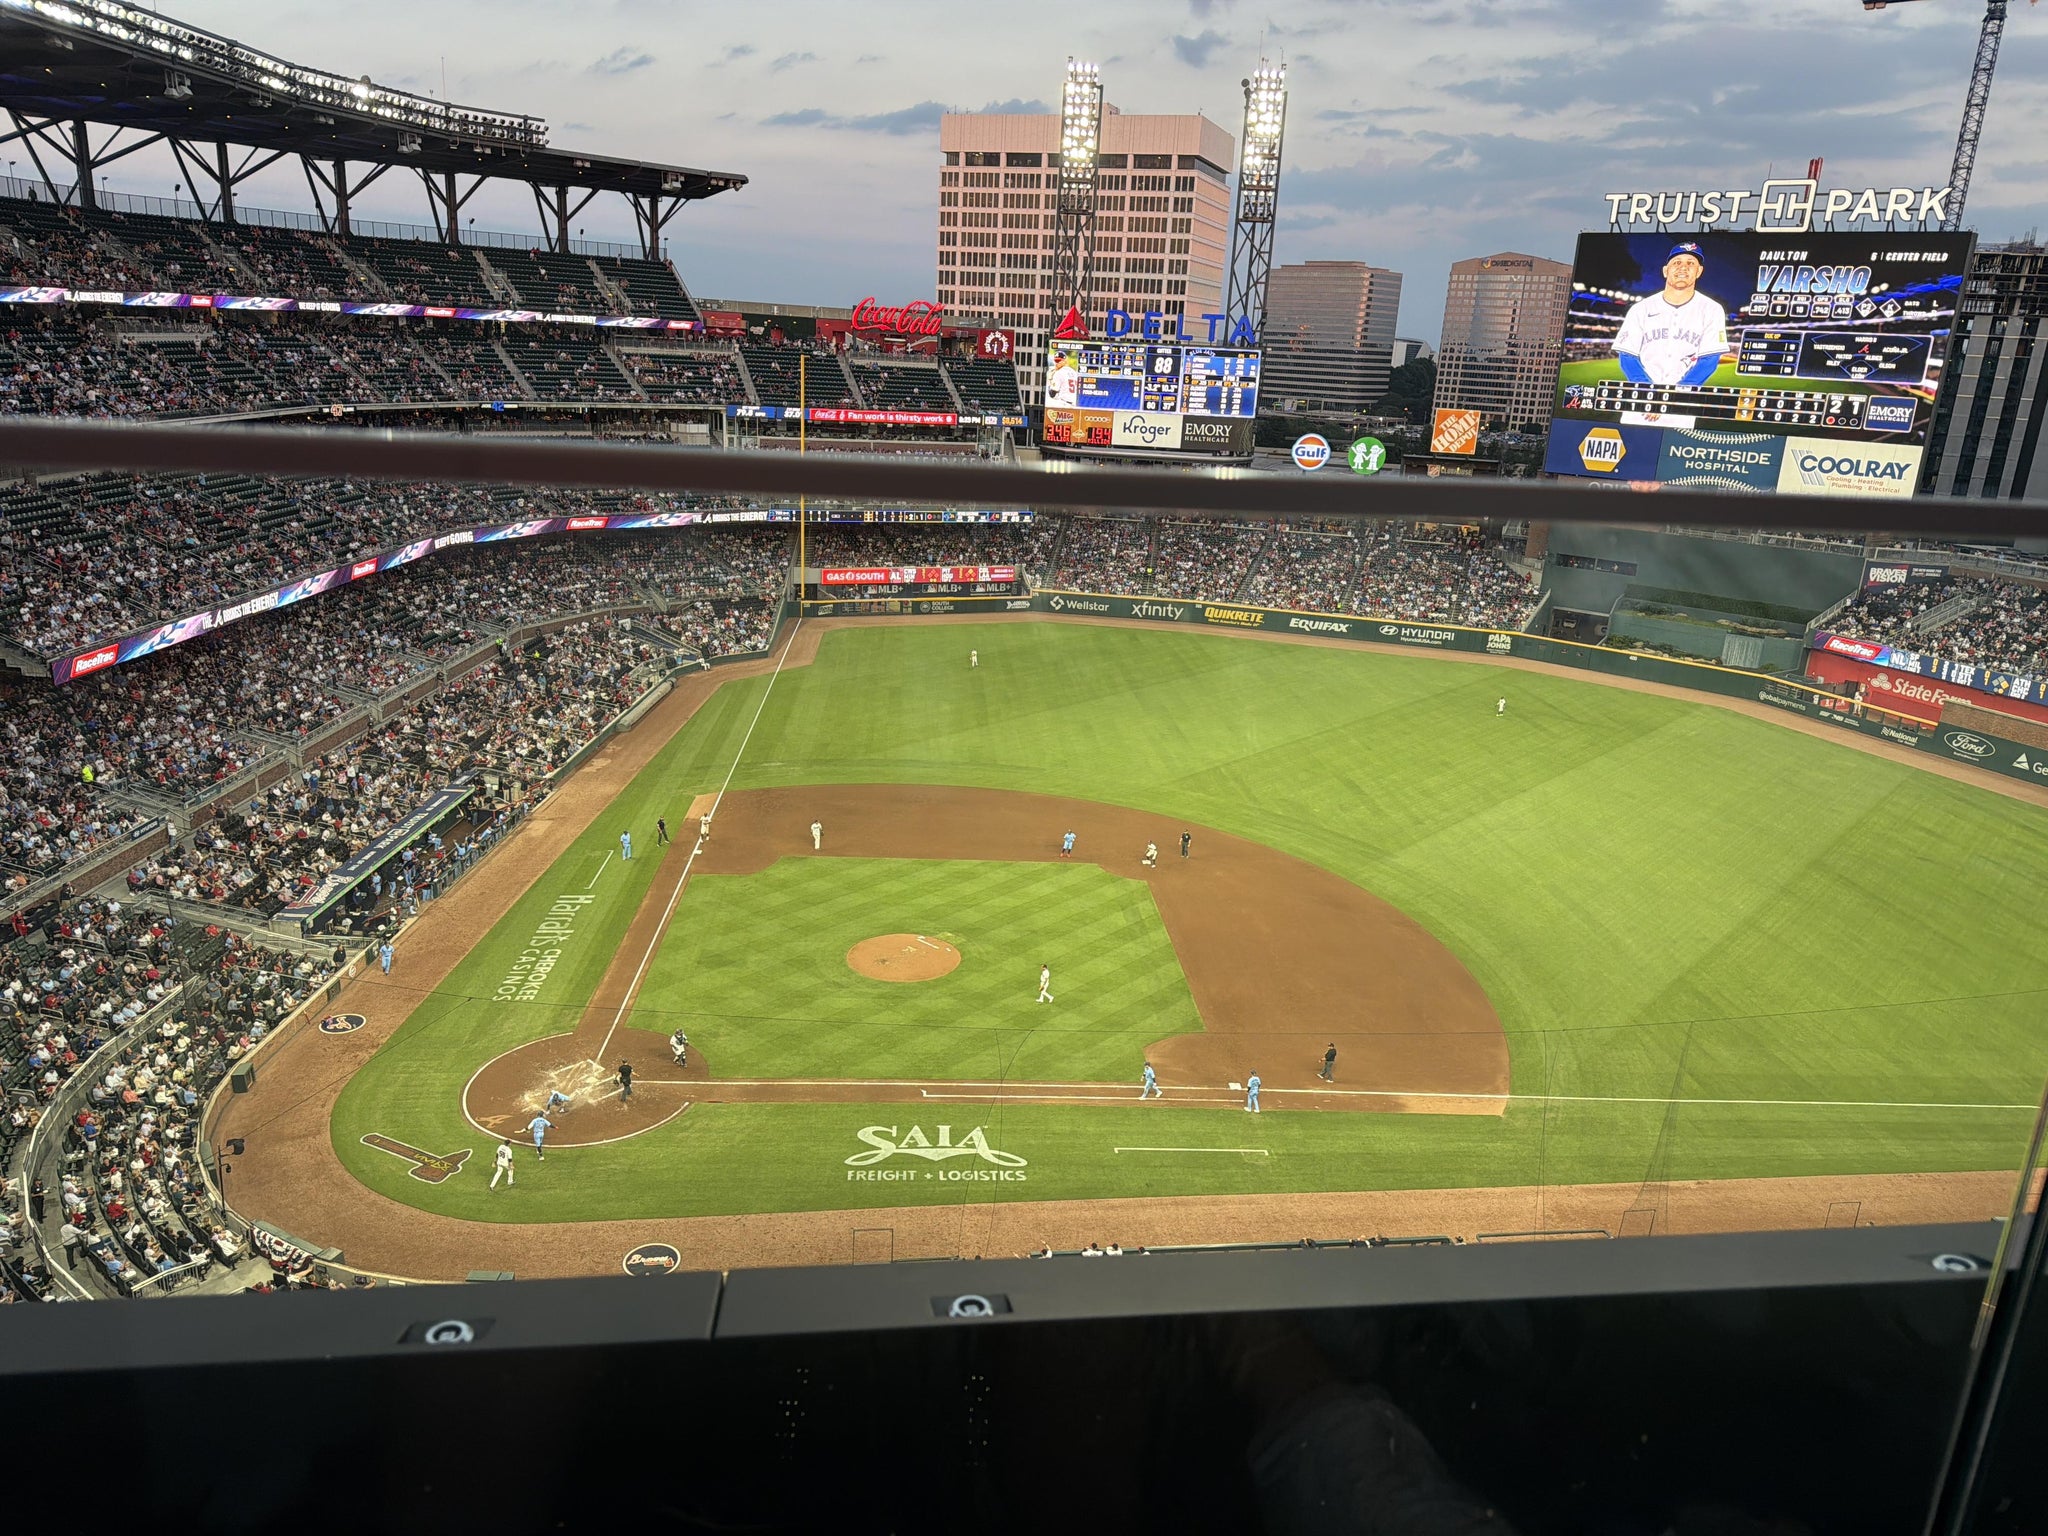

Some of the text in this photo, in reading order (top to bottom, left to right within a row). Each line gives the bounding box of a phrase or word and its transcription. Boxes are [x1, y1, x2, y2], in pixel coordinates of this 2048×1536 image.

[1604, 187, 1952, 223] TRUIST PARK
[1759, 250, 1808, 261] DAULTON
[1885, 252, 1948, 262] CENTER FIELD
[1756, 265, 1872, 294] VARSHO
[1106, 309, 1256, 345] DELTA
[1154, 357, 1173, 374] 88
[492, 402, 504, 411] 42
[1601, 389, 1608, 397] 0
[1616, 390, 1623, 398] 2
[1632, 391, 1638, 399] 0
[1647, 391, 1653, 400] 0
[1662, 392, 1669, 401] 0
[1777, 400, 1784, 408] 0
[1794, 401, 1801, 410] 2
[1813, 402, 1818, 411] 1
[1830, 400, 1841, 414] 2
[1614, 402, 1621, 410] 0
[1631, 403, 1636, 411] 1
[1645, 404, 1651, 412] 0
[1660, 405, 1667, 413] 0
[1741, 410, 1748, 418] 3
[1757, 411, 1764, 420] 4
[1774, 413, 1782, 421] 0
[1792, 414, 1799, 422] 2
[1809, 415, 1816, 424] 2
[1852, 401, 1860, 415] 1
[1869, 405, 1913, 418] EMORY
[848, 411, 862, 419] Fan
[865, 412, 884, 420] work
[896, 413, 921, 422] thirsty
[923, 414, 943, 422] work
[1439, 414, 1458, 431] THE
[1868, 415, 1909, 423] HEALTHCARE
[1047, 424, 1071, 436] 346
[1092, 427, 1112, 439] 194
[1123, 415, 1171, 443] Kroger
[1185, 423, 1232, 437] EMORY
[1432, 411, 1480, 452] HOME
[1448, 426, 1477, 452] DEPOT
[1295, 446, 1326, 459] Gulf
[1585, 441, 1619, 460] NAPA
[1669, 445, 1772, 466] NORTHSIDE
[1685, 461, 1749, 474] HOSPITAL
[1800, 454, 1912, 480] COOLRAY
[1826, 475, 1884, 486] Cooling Heating
[1831, 482, 1900, 494] Plumbing Electrical
[740, 510, 768, 522] ENERGY
[450, 531, 473, 545] GOING
[826, 572, 885, 581] GAS SOUTH
[890, 571, 901, 580] AL
[1869, 574, 1907, 584] VISION
[1870, 567, 1908, 577] BRAVES
[938, 583, 962, 593] MLB+
[986, 583, 1011, 592] MLB+
[250, 592, 279, 614] ENERGY
[1066, 600, 1110, 612] Wellstar
[1131, 601, 1184, 620] xfinity
[1204, 607, 1264, 623] QUIKRETE
[1289, 617, 1348, 633] EQUIFAX
[1401, 627, 1455, 641] HYUNDAI
[1488, 634, 1511, 643] PAPA
[1486, 641, 1511, 650] JOHNS
[1829, 639, 1874, 657] RaceTrac
[75, 651, 114, 672] RaceTrac
[1890, 653, 1906, 666] NL
[1959, 664, 1975, 675] TEX
[1892, 678, 1931, 702] State
[2013, 678, 2031, 688] ATH
[1890, 730, 1918, 744] National
[1952, 734, 1987, 754] Ford
[492, 948, 540, 1001] CASINOS
[514, 948, 562, 1001] CHEROKEE
[844, 1124, 1028, 1167] SAIA
[847, 1170, 917, 1181] FREIGHT
[939, 1170, 1027, 1181] LOGISTICS
[627, 1253, 669, 1265] Braves
